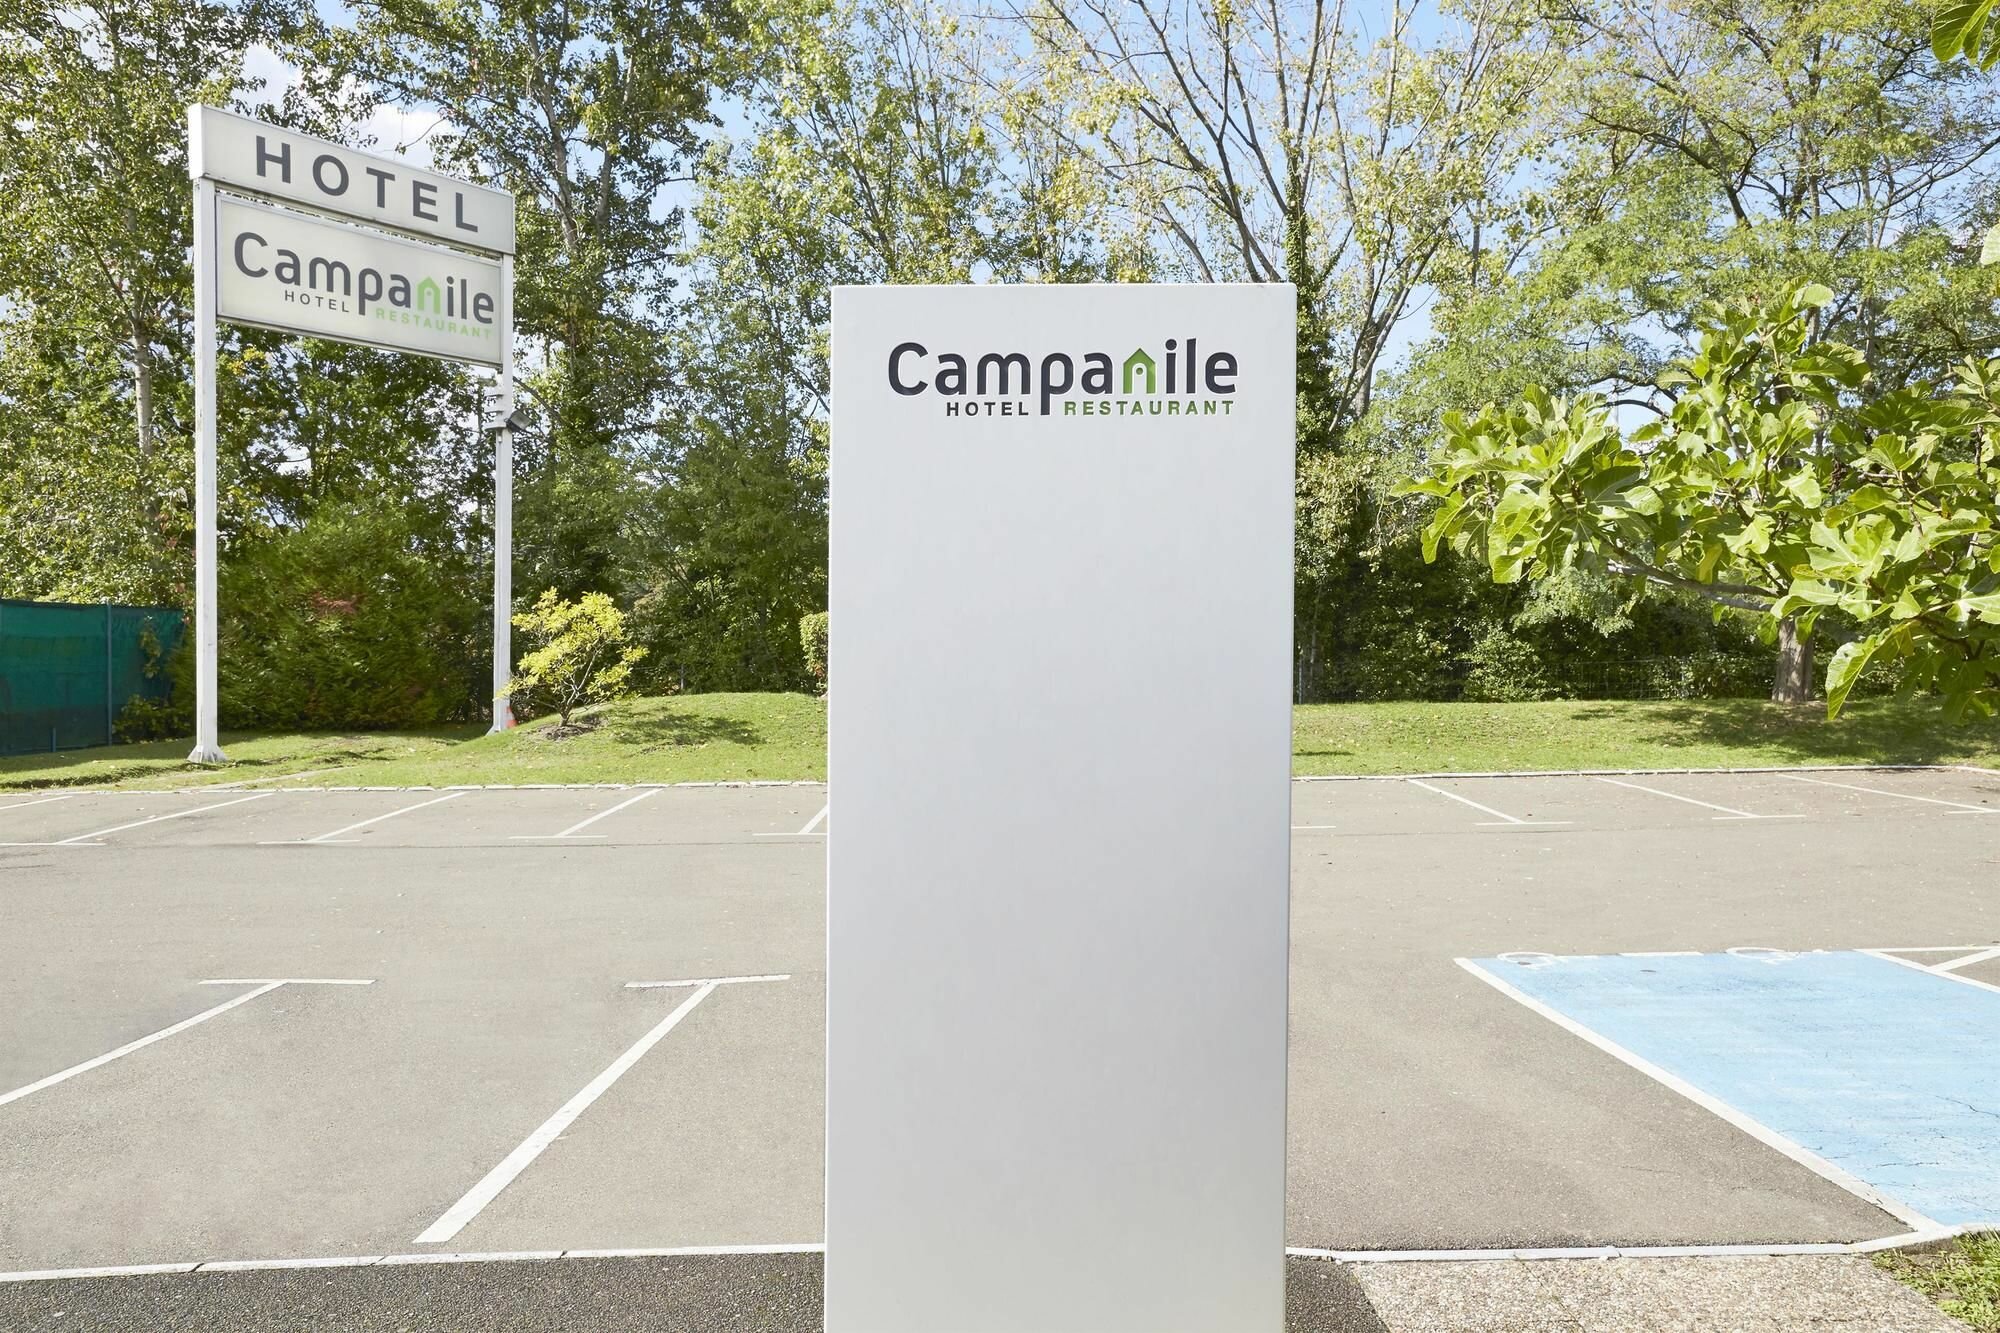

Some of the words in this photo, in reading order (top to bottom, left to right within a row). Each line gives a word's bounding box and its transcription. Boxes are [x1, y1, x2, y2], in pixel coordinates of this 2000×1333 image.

[256, 135, 478, 233] HOTEL
[234, 232, 494, 324] Campanile
[284, 290, 350, 313] HOTEL
[376, 308, 492, 340] RESTAURANT
[888, 338, 1239, 416] Campanile
[946, 402, 1029, 416] HOTEL
[1064, 401, 1234, 415] RESTAURANT
